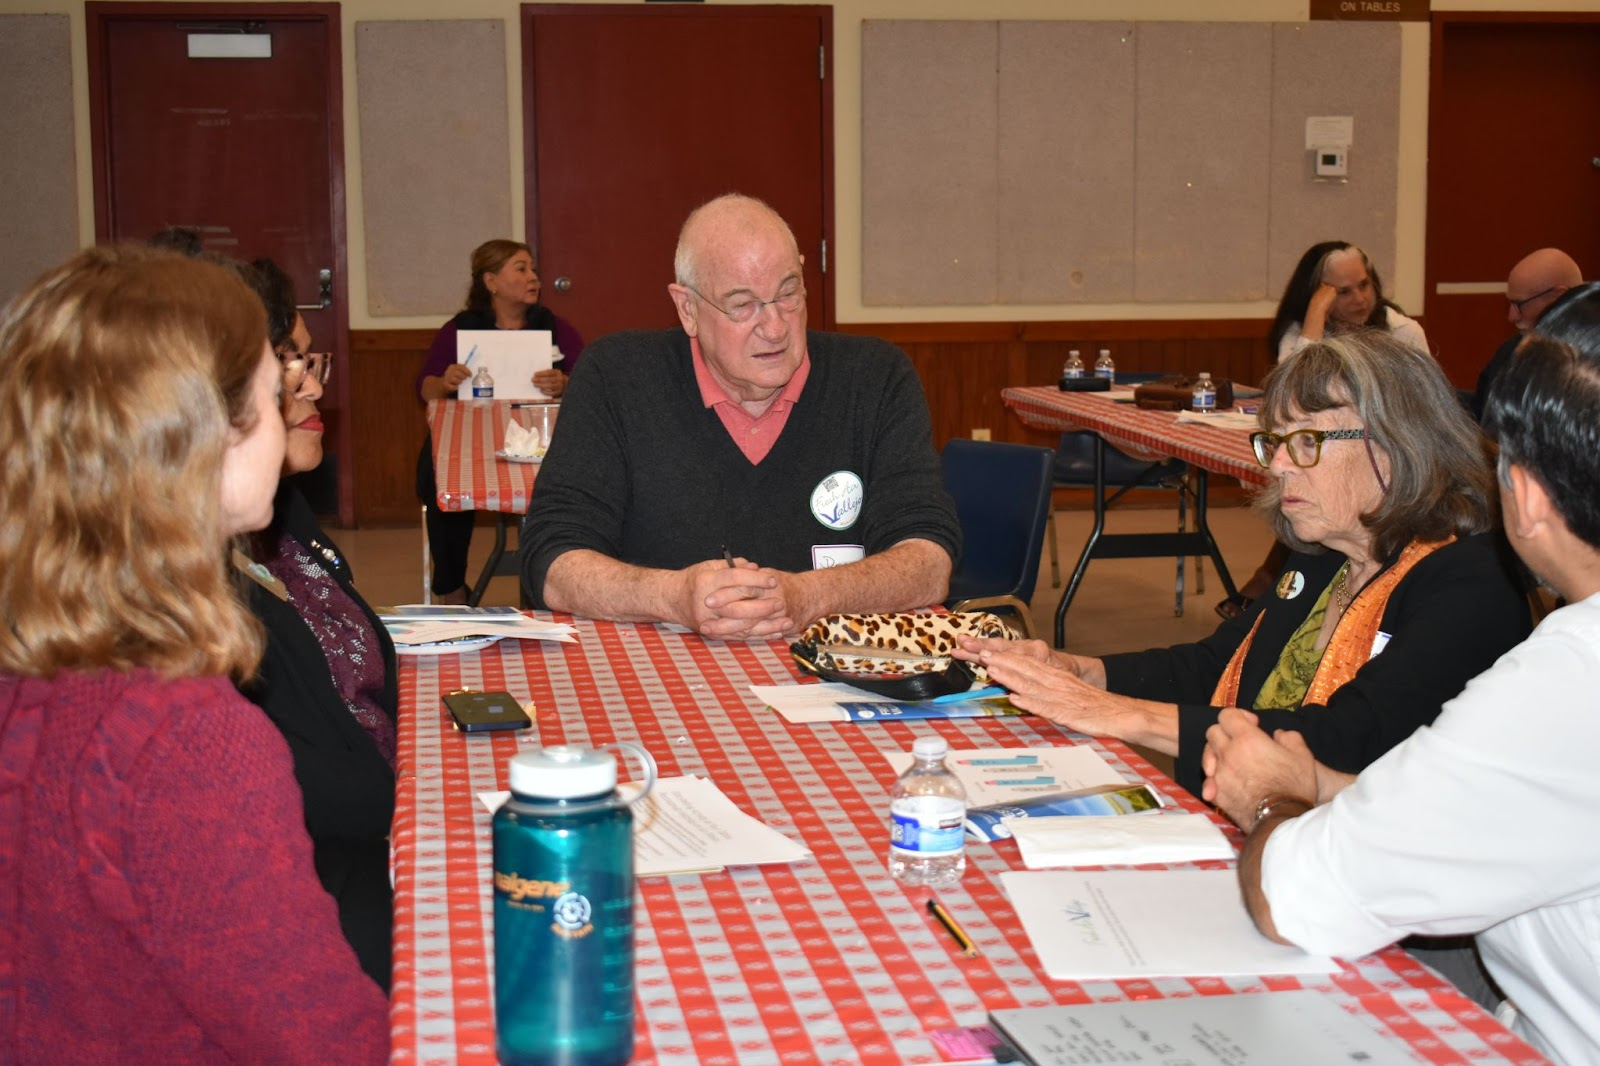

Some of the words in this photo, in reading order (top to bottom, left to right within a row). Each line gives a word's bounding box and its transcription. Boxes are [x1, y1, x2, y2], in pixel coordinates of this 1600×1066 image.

[1340, 1, 1356, 12] ON
[1361, 2, 1400, 13] TABLES
[815, 490, 840, 513] Fresh
[841, 481, 859, 498] Air
[820, 497, 862, 524] Vallejo
